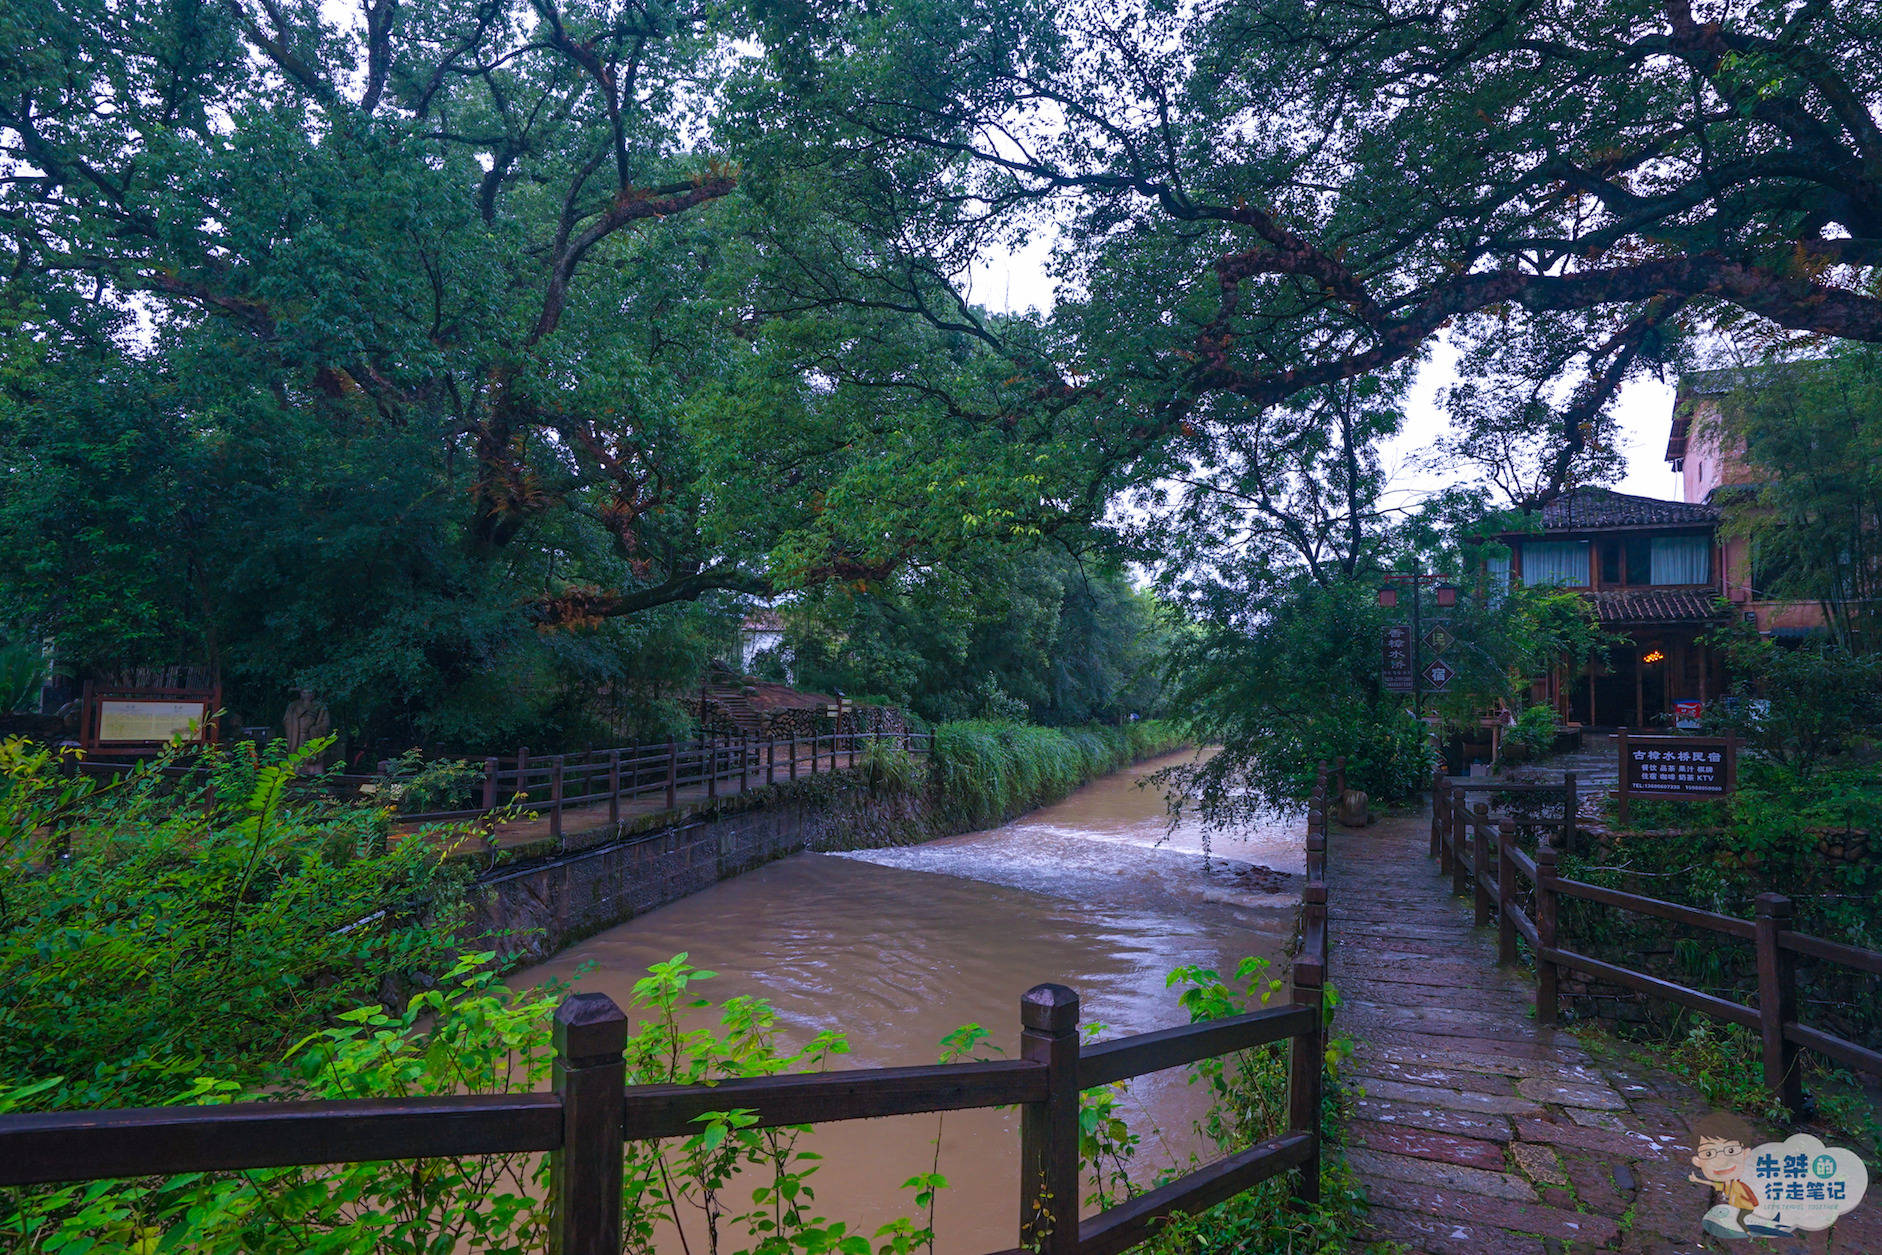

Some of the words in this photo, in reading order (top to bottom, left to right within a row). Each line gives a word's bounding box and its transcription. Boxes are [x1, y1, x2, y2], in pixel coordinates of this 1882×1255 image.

[1431, 667, 1446, 681] 宿
[1632, 750, 1722, 763] 古樟水桥民宿
